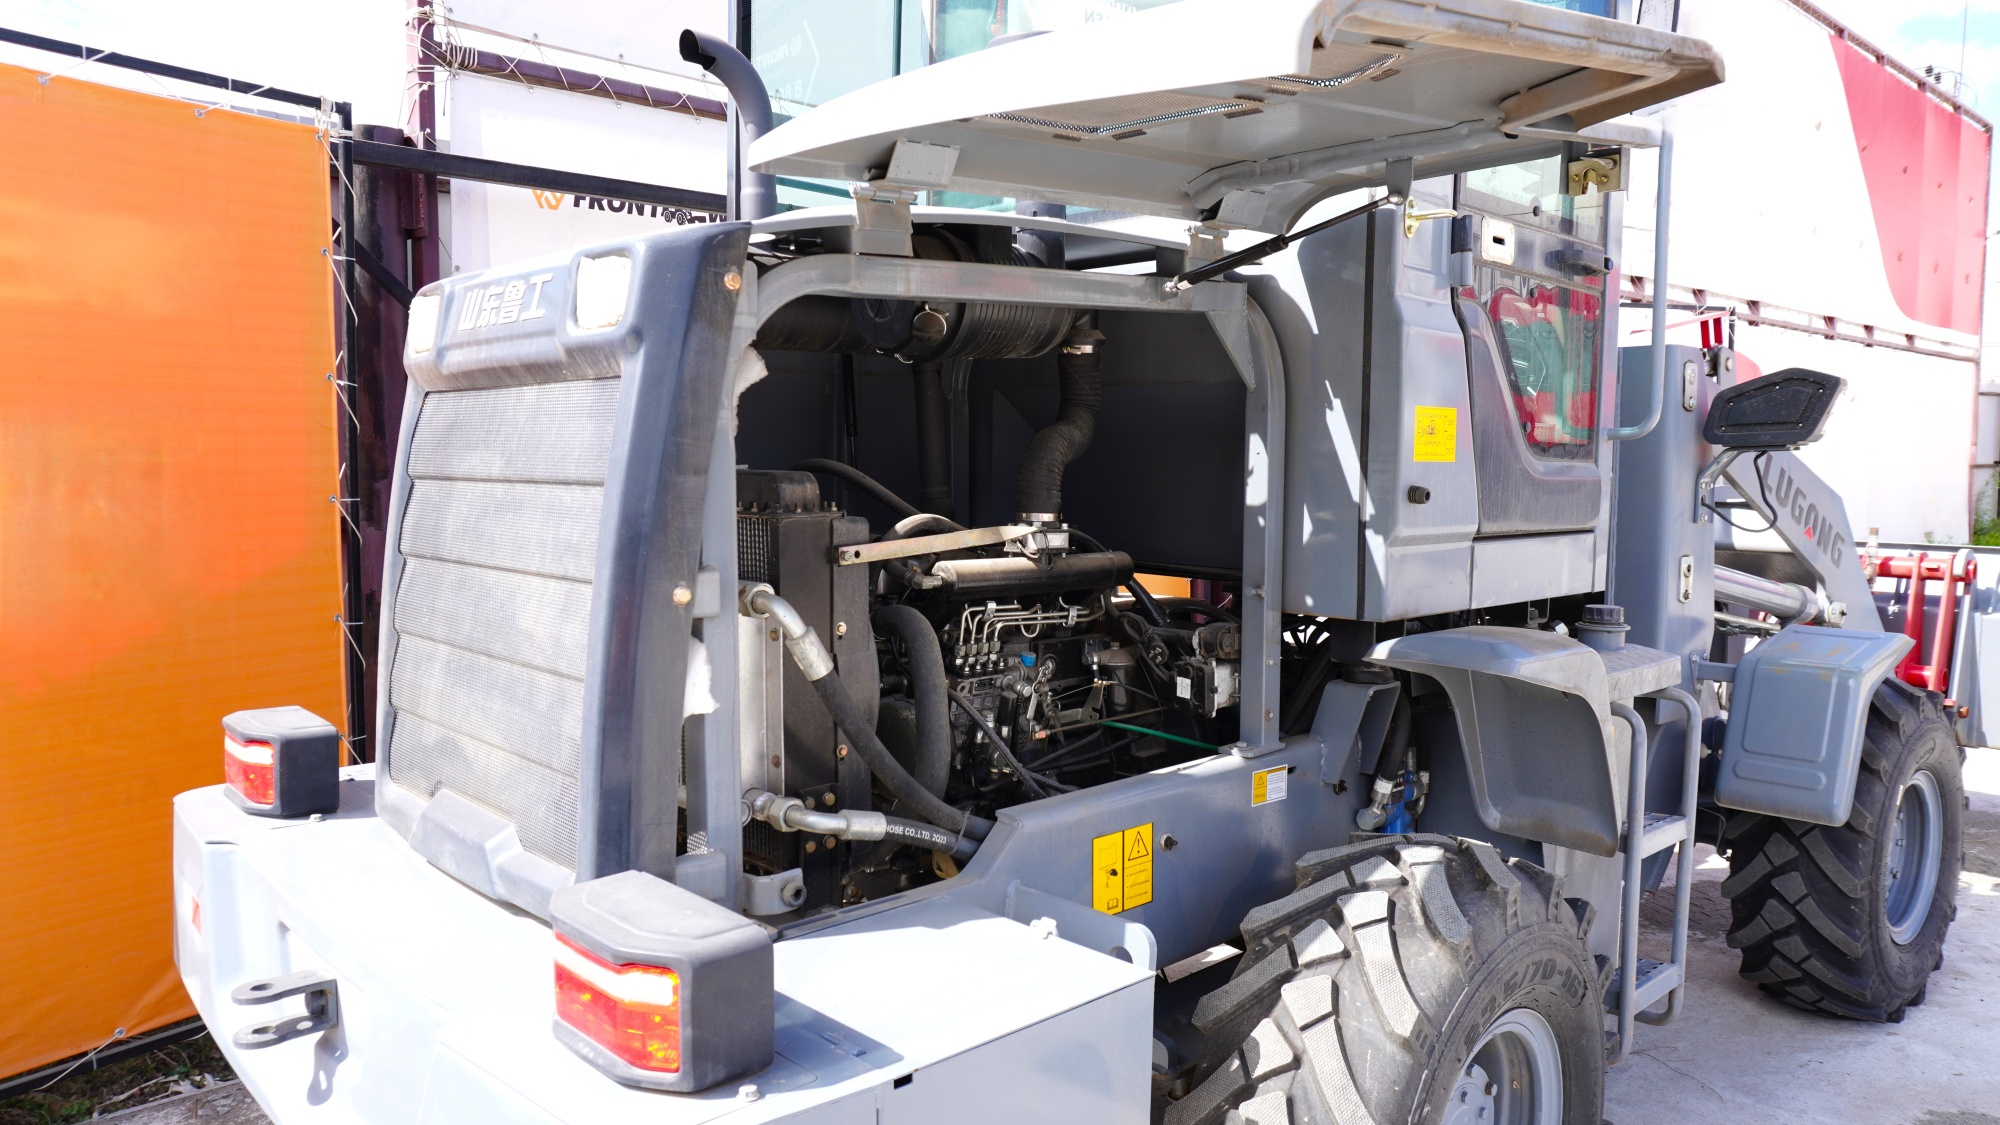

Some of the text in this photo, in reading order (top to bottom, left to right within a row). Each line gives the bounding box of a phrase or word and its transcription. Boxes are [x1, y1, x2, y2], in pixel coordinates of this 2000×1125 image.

[458, 272, 554, 332] 山东鲁工
[1762, 451, 1846, 569] LUGONG
